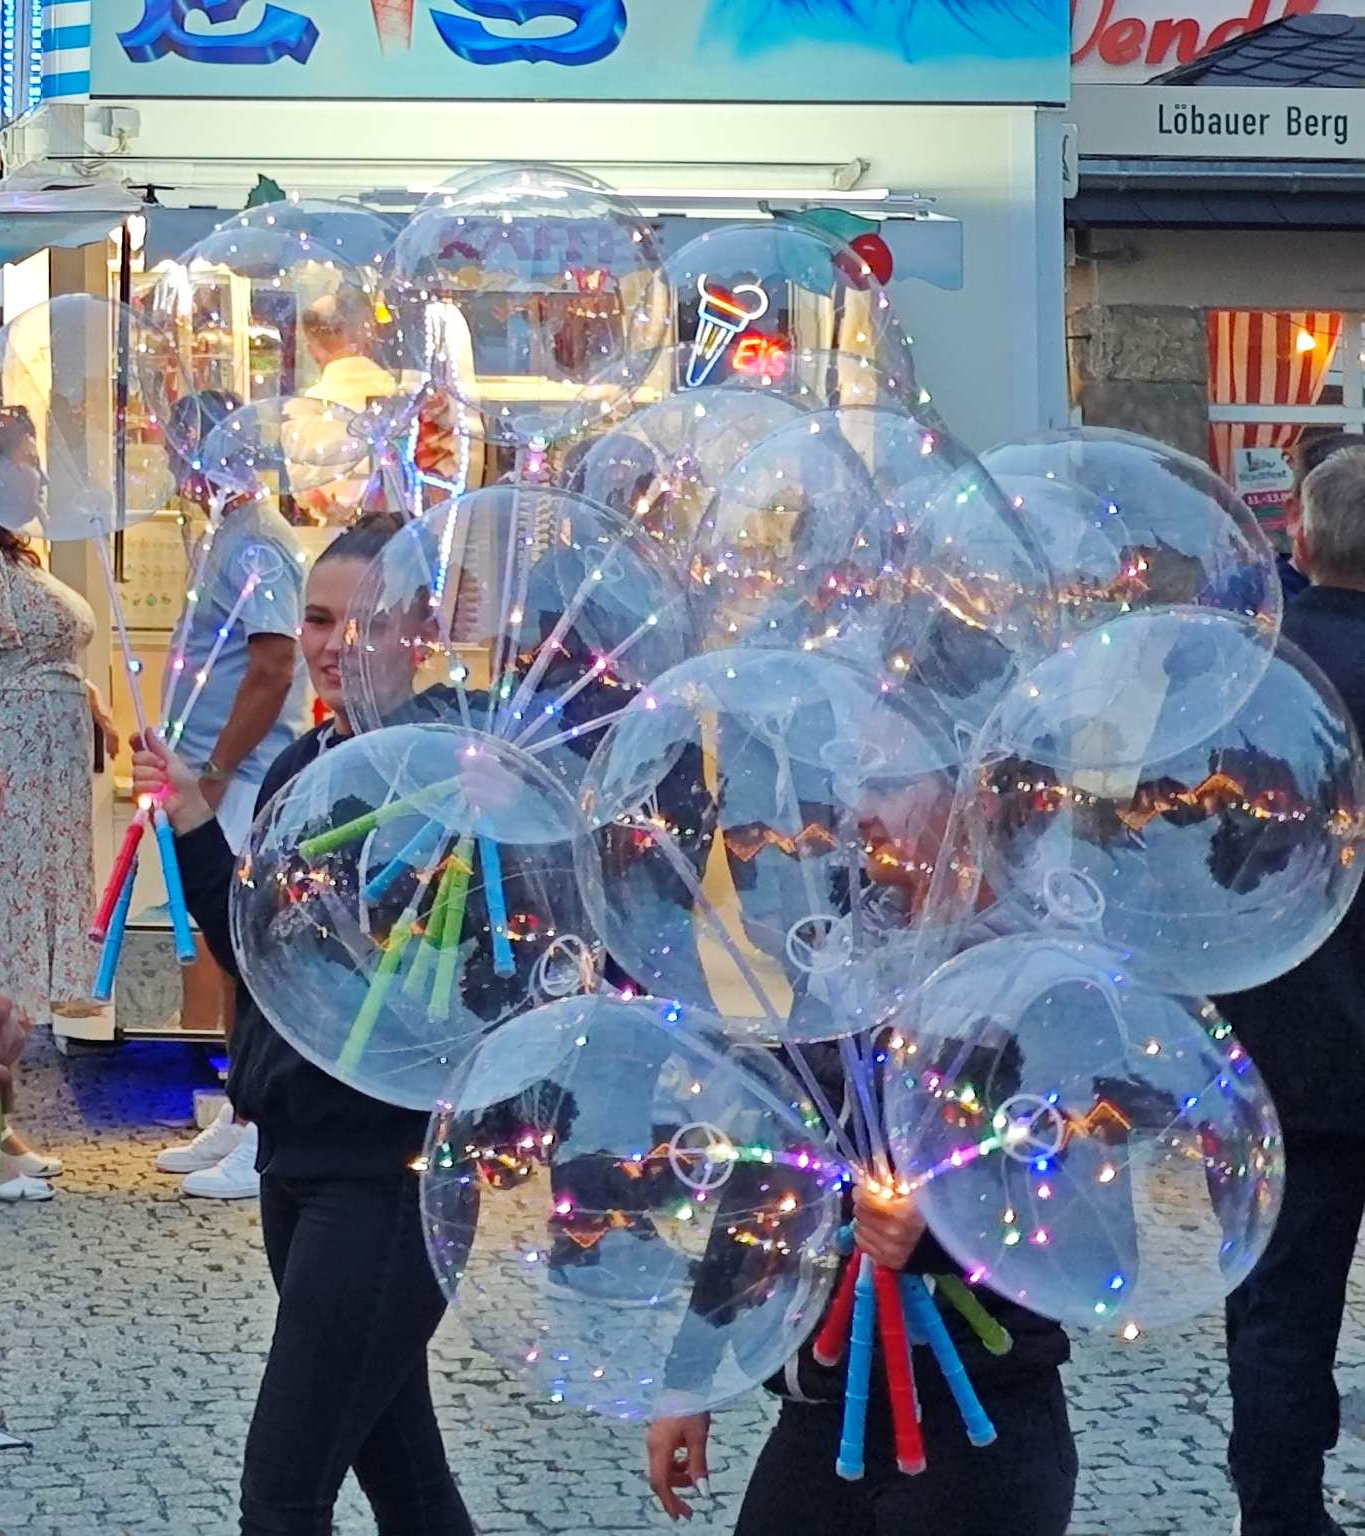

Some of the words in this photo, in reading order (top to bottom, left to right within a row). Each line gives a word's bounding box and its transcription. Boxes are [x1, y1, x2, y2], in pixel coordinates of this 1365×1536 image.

[1158, 103, 1269, 136] Löbauer
[1286, 106, 1348, 145] Berg
[732, 336, 787, 377] Eis
